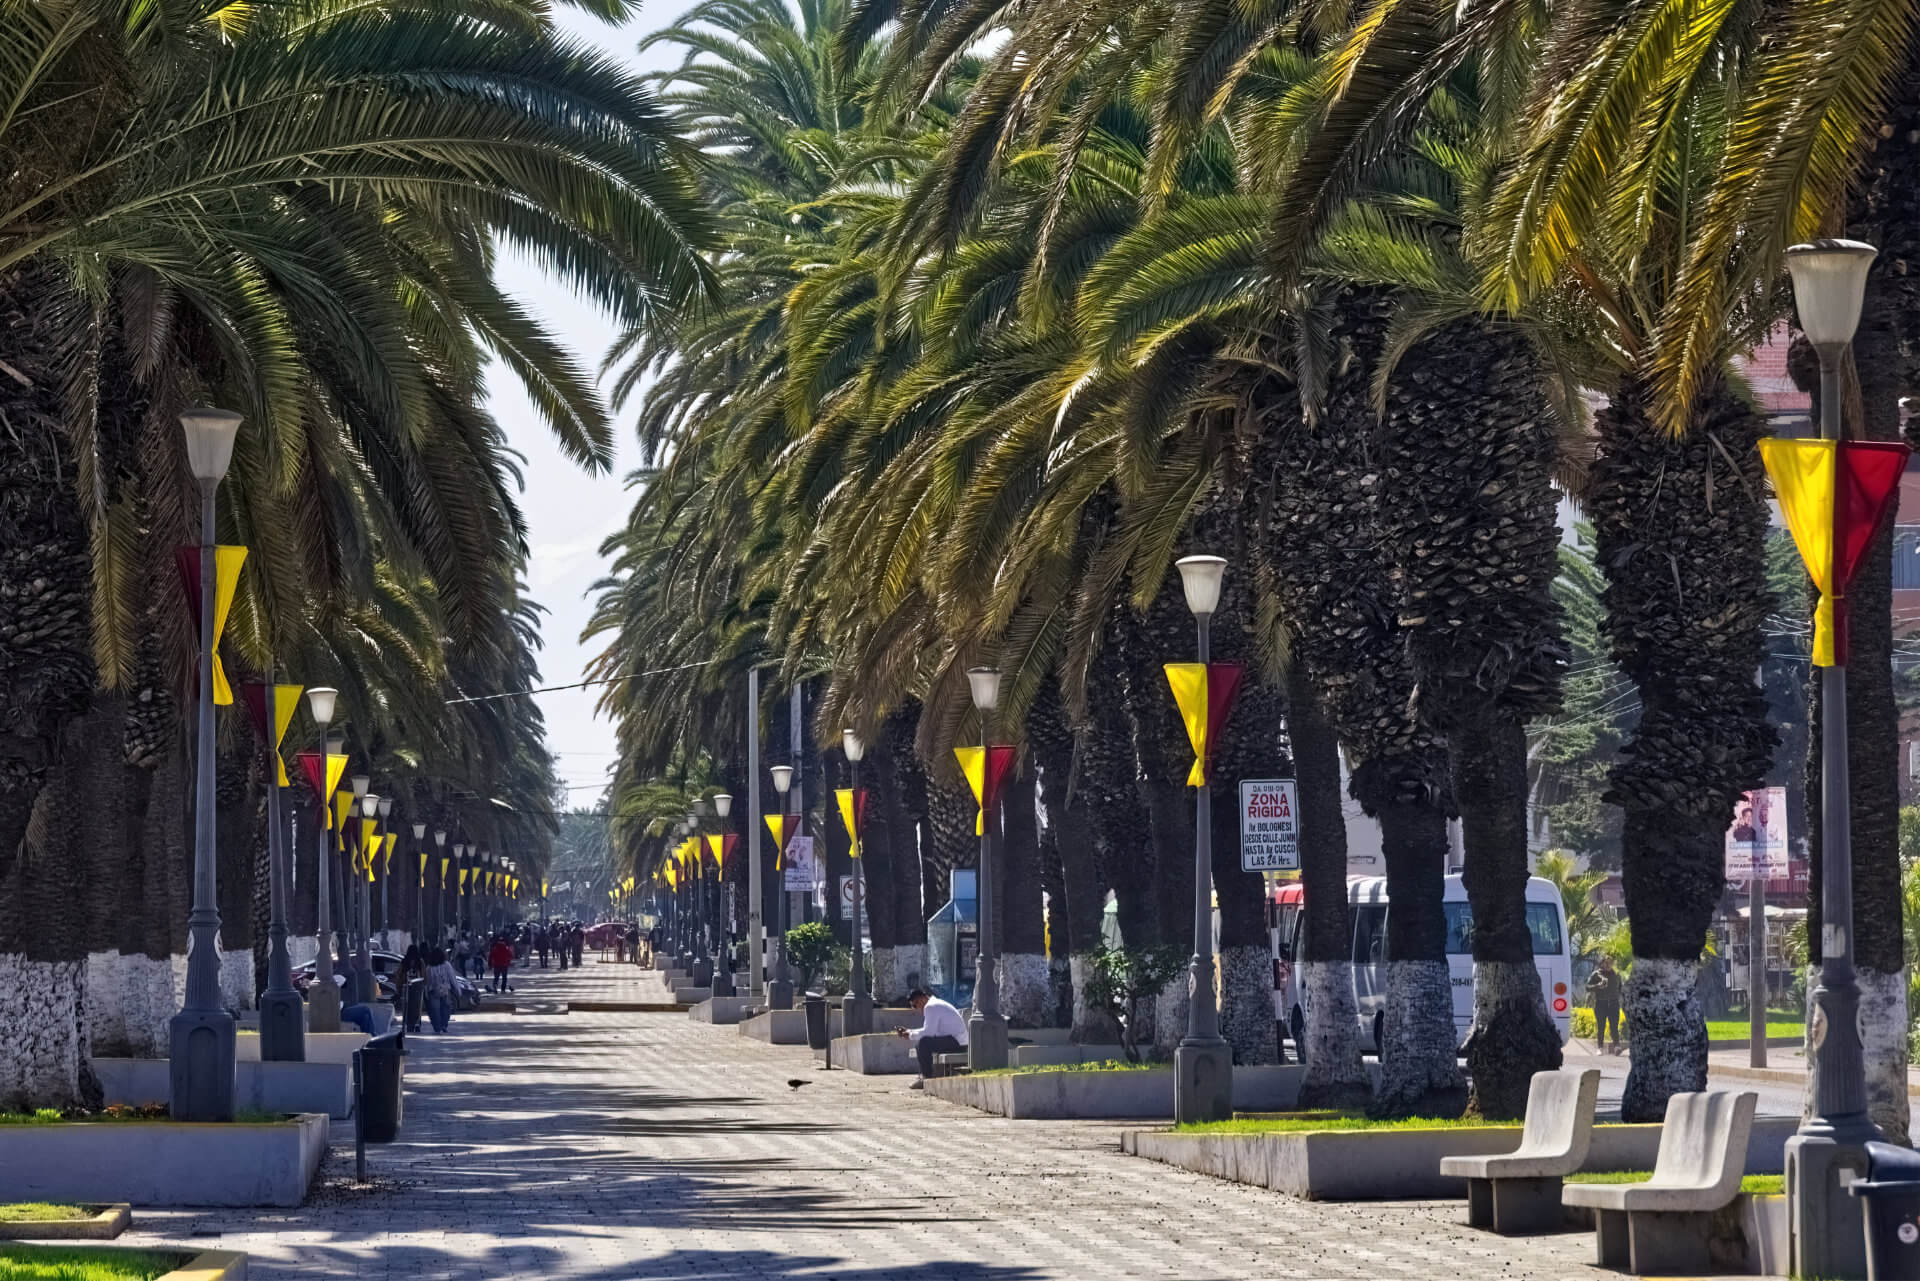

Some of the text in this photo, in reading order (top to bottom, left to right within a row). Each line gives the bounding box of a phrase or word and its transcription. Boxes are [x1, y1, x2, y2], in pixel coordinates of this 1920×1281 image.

[1250, 793, 1288, 805] ZONA
[1248, 806, 1290, 818] RIGIDA
[1257, 821, 1292, 832] BOLOGNESI
[1245, 833, 1261, 844] DESDE
[1245, 845, 1264, 855] HASTA
[1274, 844, 1296, 854] CUSCO
[1252, 856, 1265, 866] LAS
[1267, 854, 1277, 865] 24
